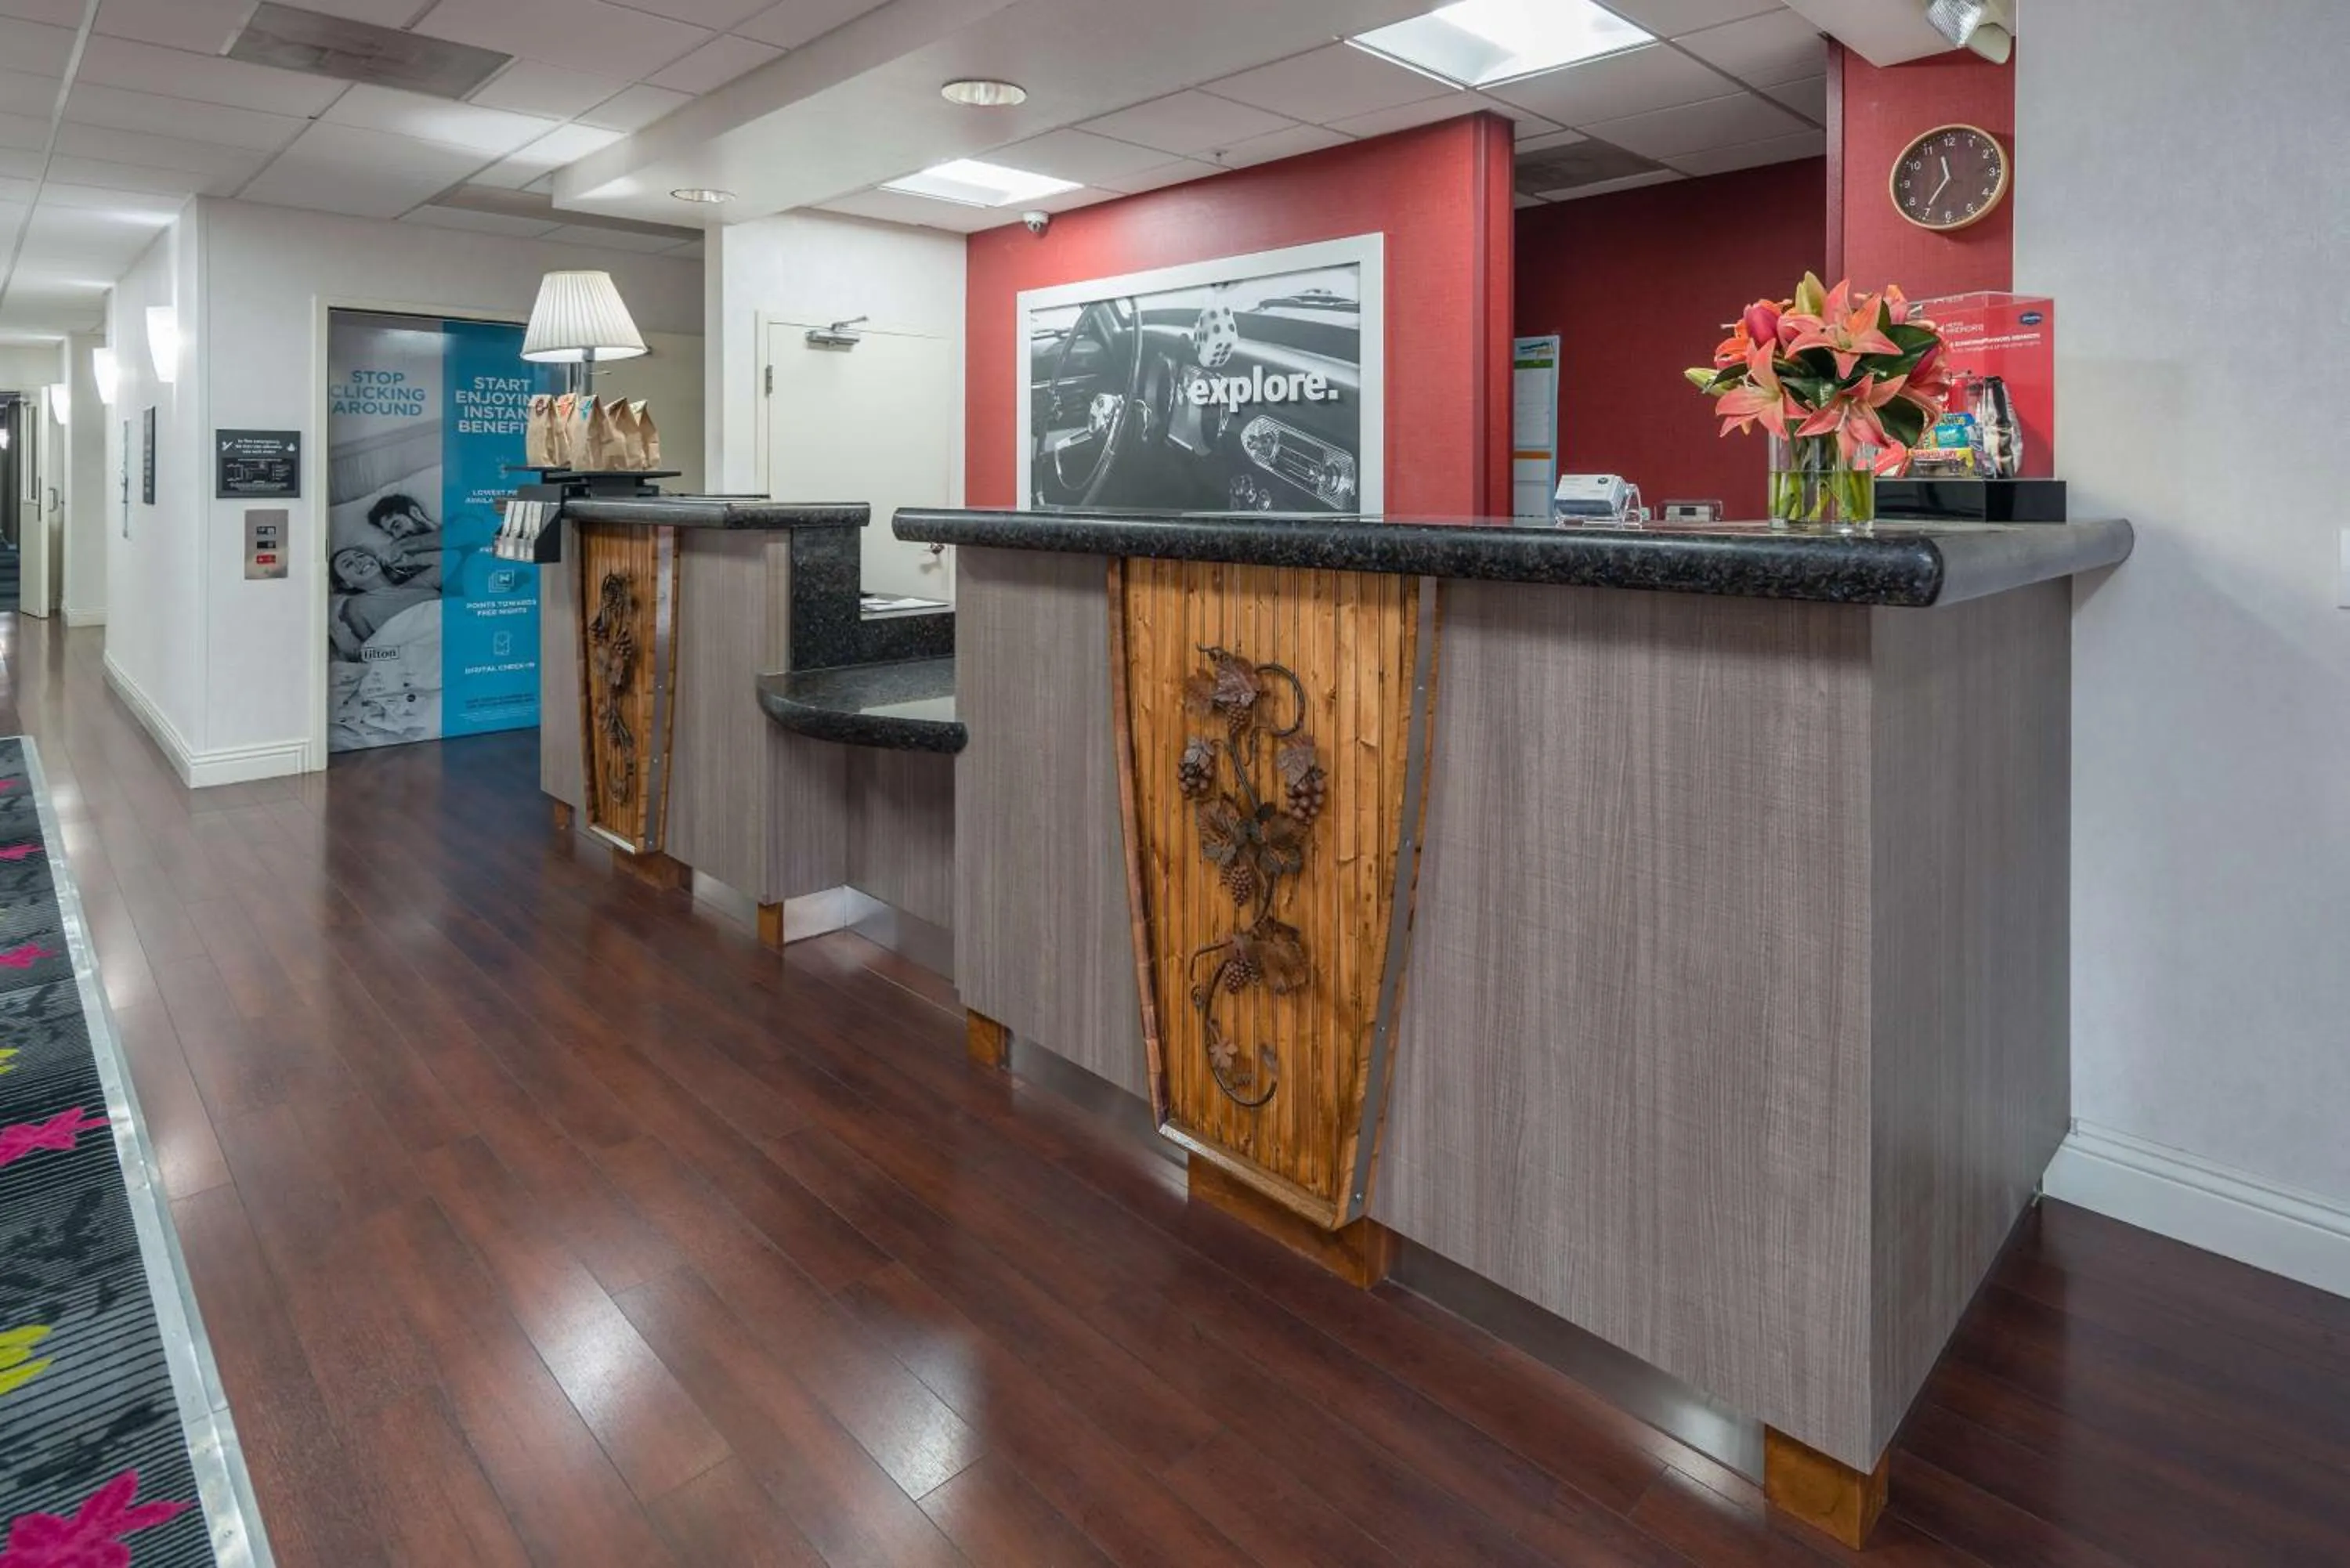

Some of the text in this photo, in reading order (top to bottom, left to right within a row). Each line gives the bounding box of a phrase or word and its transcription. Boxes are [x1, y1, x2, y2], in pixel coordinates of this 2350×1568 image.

[1944, 138, 1956, 146] 12
[1924, 146, 1933, 155] 11
[1983, 150, 1990, 159] 2
[1910, 161, 1922, 171] 10
[1989, 167, 1996, 176] 3
[1904, 180, 1911, 189] 9
[1909, 197, 1916, 206] 8
[1965, 201, 1973, 212] 5
[1924, 208, 1931, 217] 7
[1945, 211, 1952, 219] 6
[352, 370, 405, 385] STOP
[474, 377, 532, 391] START
[1190, 365, 1339, 413] explore.
[330, 385, 425, 402] CLICKING
[455, 390, 531, 406] ENJOYIN
[331, 401, 422, 417] AROUND
[464, 405, 530, 420] INSTAN
[457, 420, 526, 435] BENEFI
